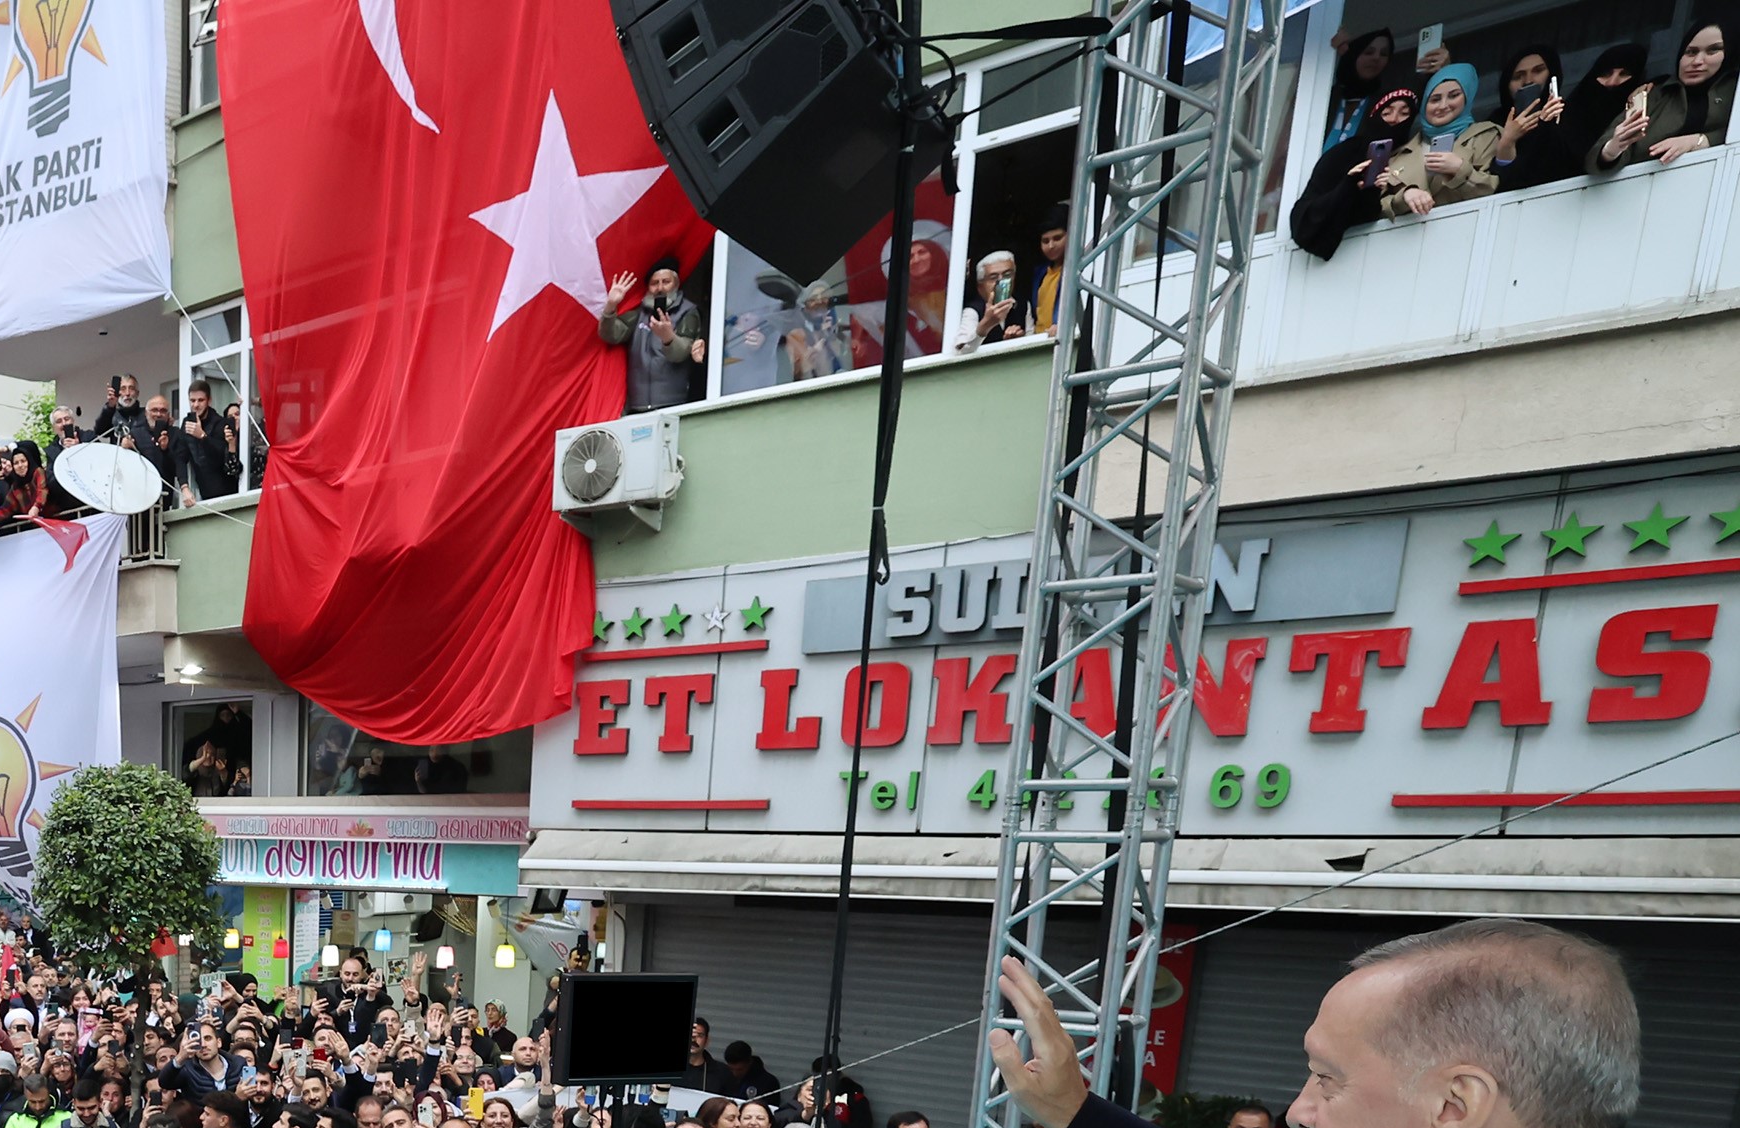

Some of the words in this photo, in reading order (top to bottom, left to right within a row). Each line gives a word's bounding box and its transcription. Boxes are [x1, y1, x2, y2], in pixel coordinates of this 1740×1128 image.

[886, 538, 1272, 639] SULN
[573, 673, 716, 757] ET
[839, 771, 921, 811] Tel
[1208, 763, 1291, 811] 69
[227, 816, 268, 836] yenigün
[270, 816, 339, 837] dondurma
[386, 818, 438, 839] yenigün
[440, 818, 523, 840] dondurma
[264, 841, 443, 882] dondurma
